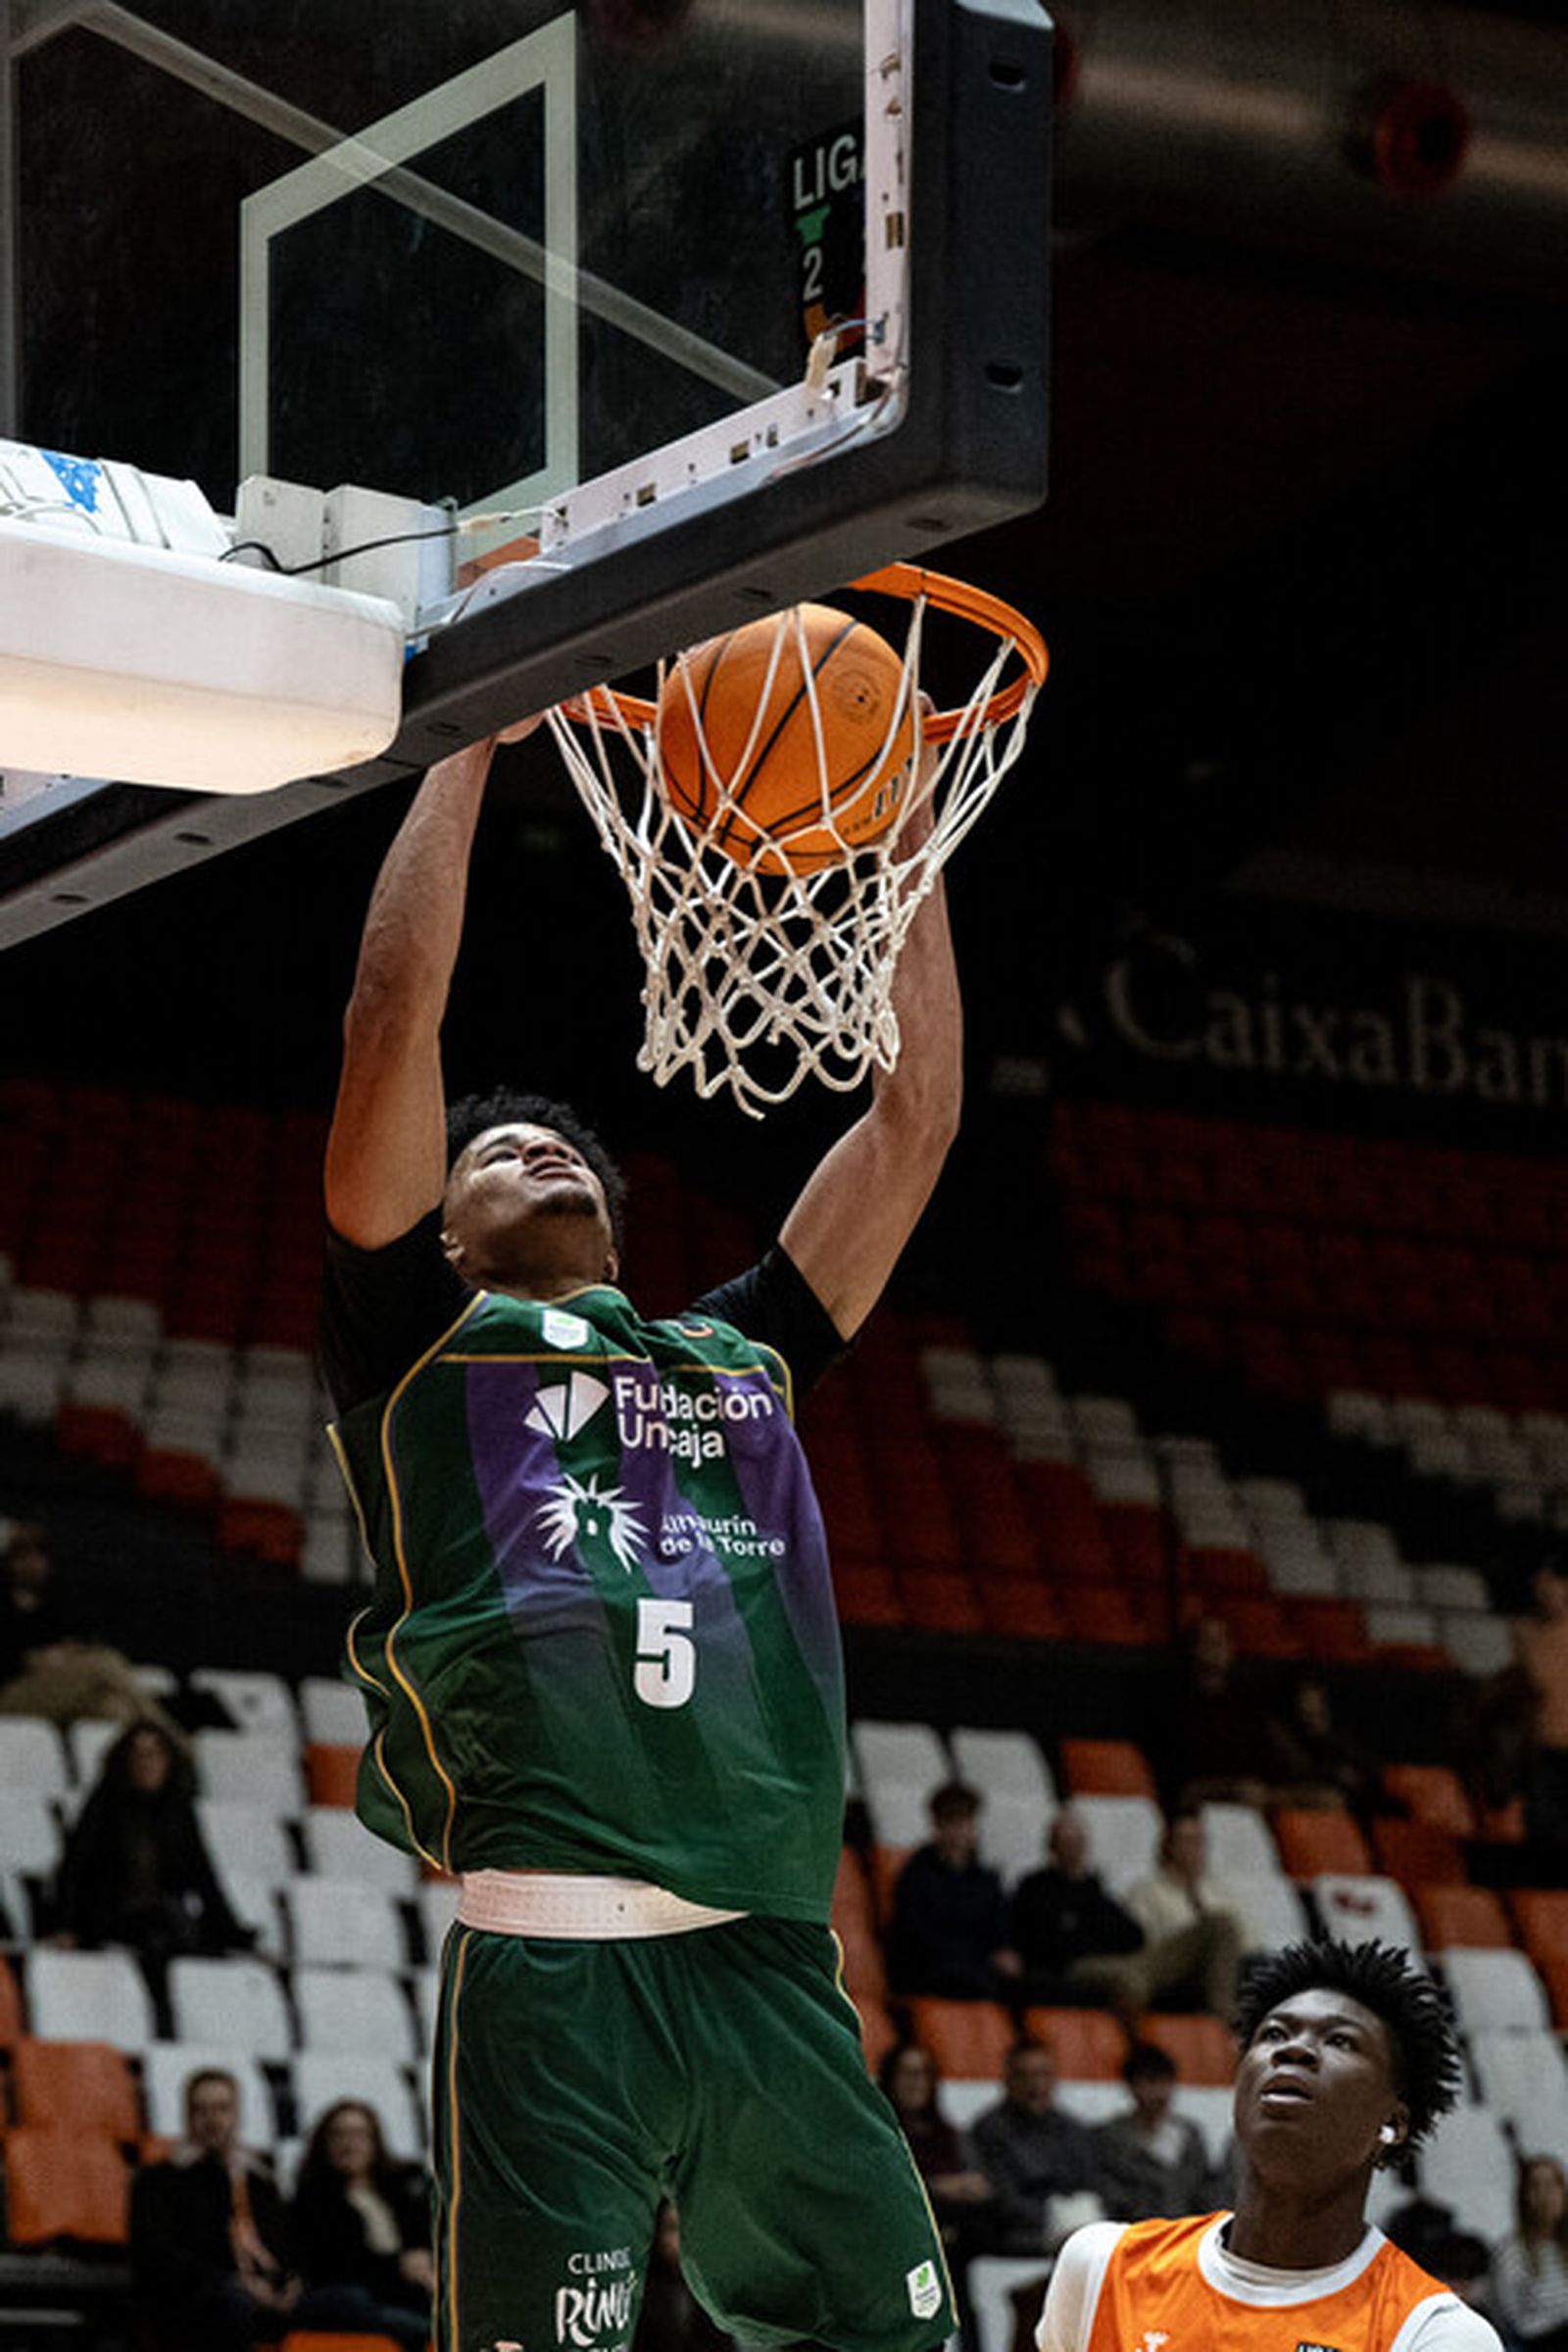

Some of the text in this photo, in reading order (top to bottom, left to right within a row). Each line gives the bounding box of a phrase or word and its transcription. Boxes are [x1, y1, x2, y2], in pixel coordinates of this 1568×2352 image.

[793, 133, 865, 211] LIG
[614, 1377, 772, 1420] Fudación
[617, 1413, 725, 1468] Uncaja
[634, 1598, 696, 1707] 5
